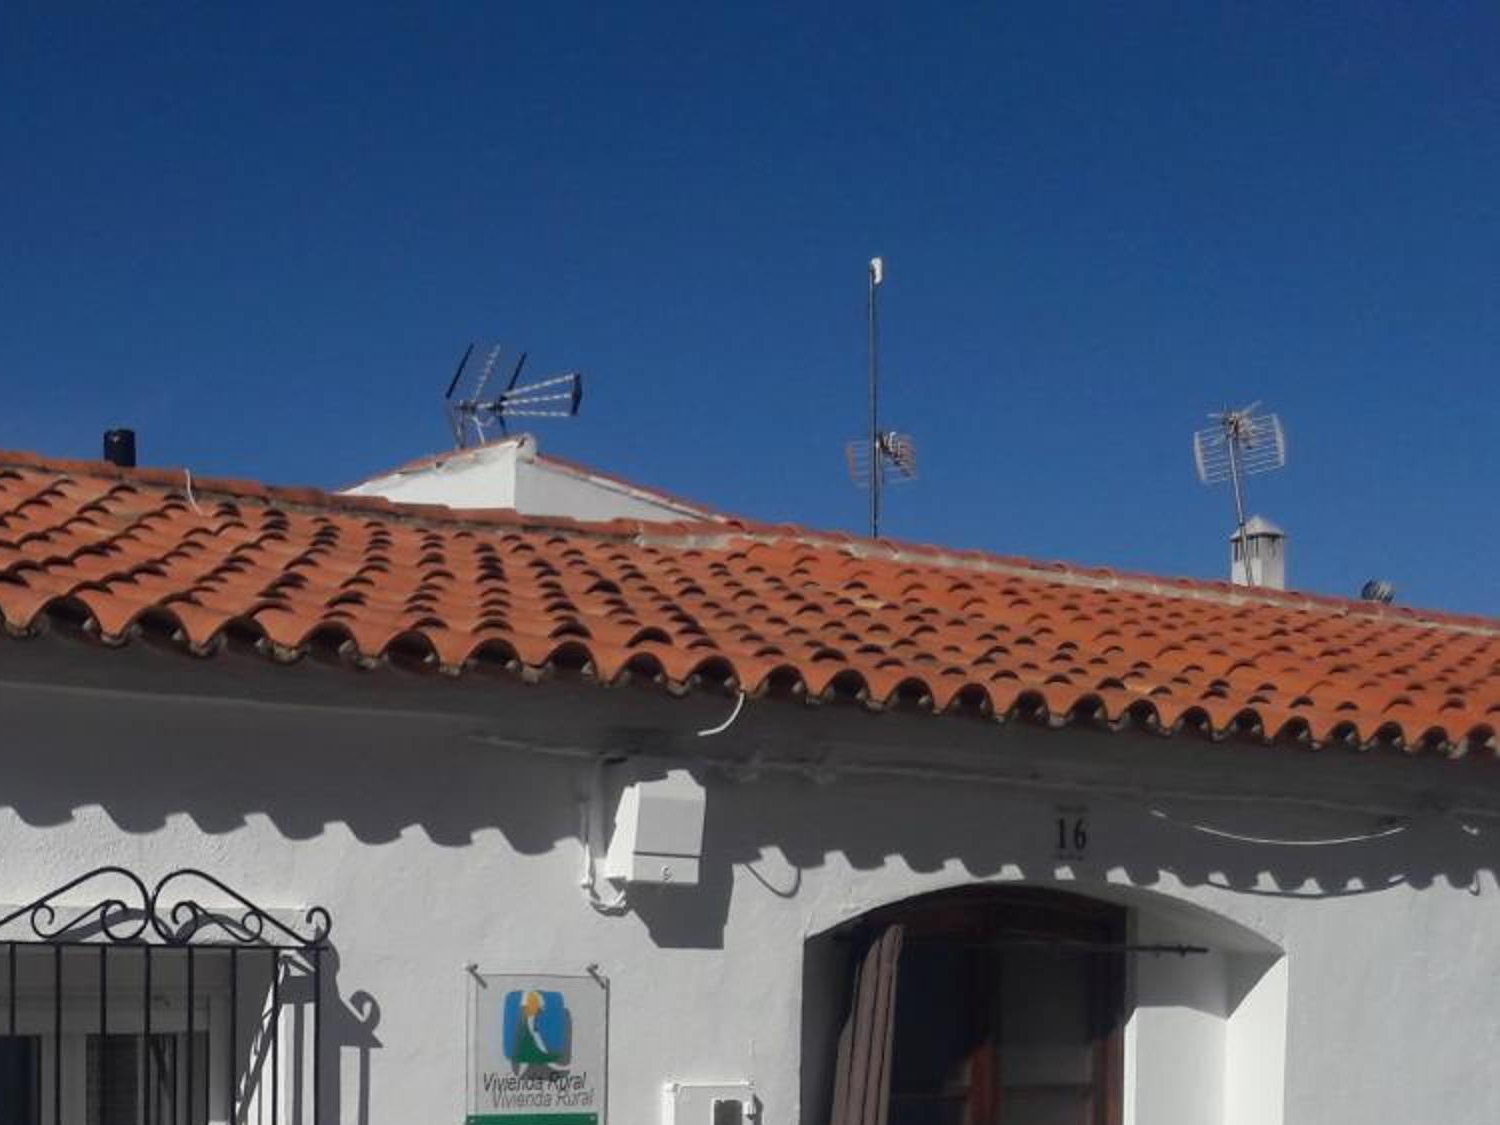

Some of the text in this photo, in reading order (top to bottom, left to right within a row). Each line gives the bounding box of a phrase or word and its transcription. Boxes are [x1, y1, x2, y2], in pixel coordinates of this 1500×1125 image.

[1058, 817, 1087, 851] 16
[483, 1071, 587, 1092] Vivienda Rural
